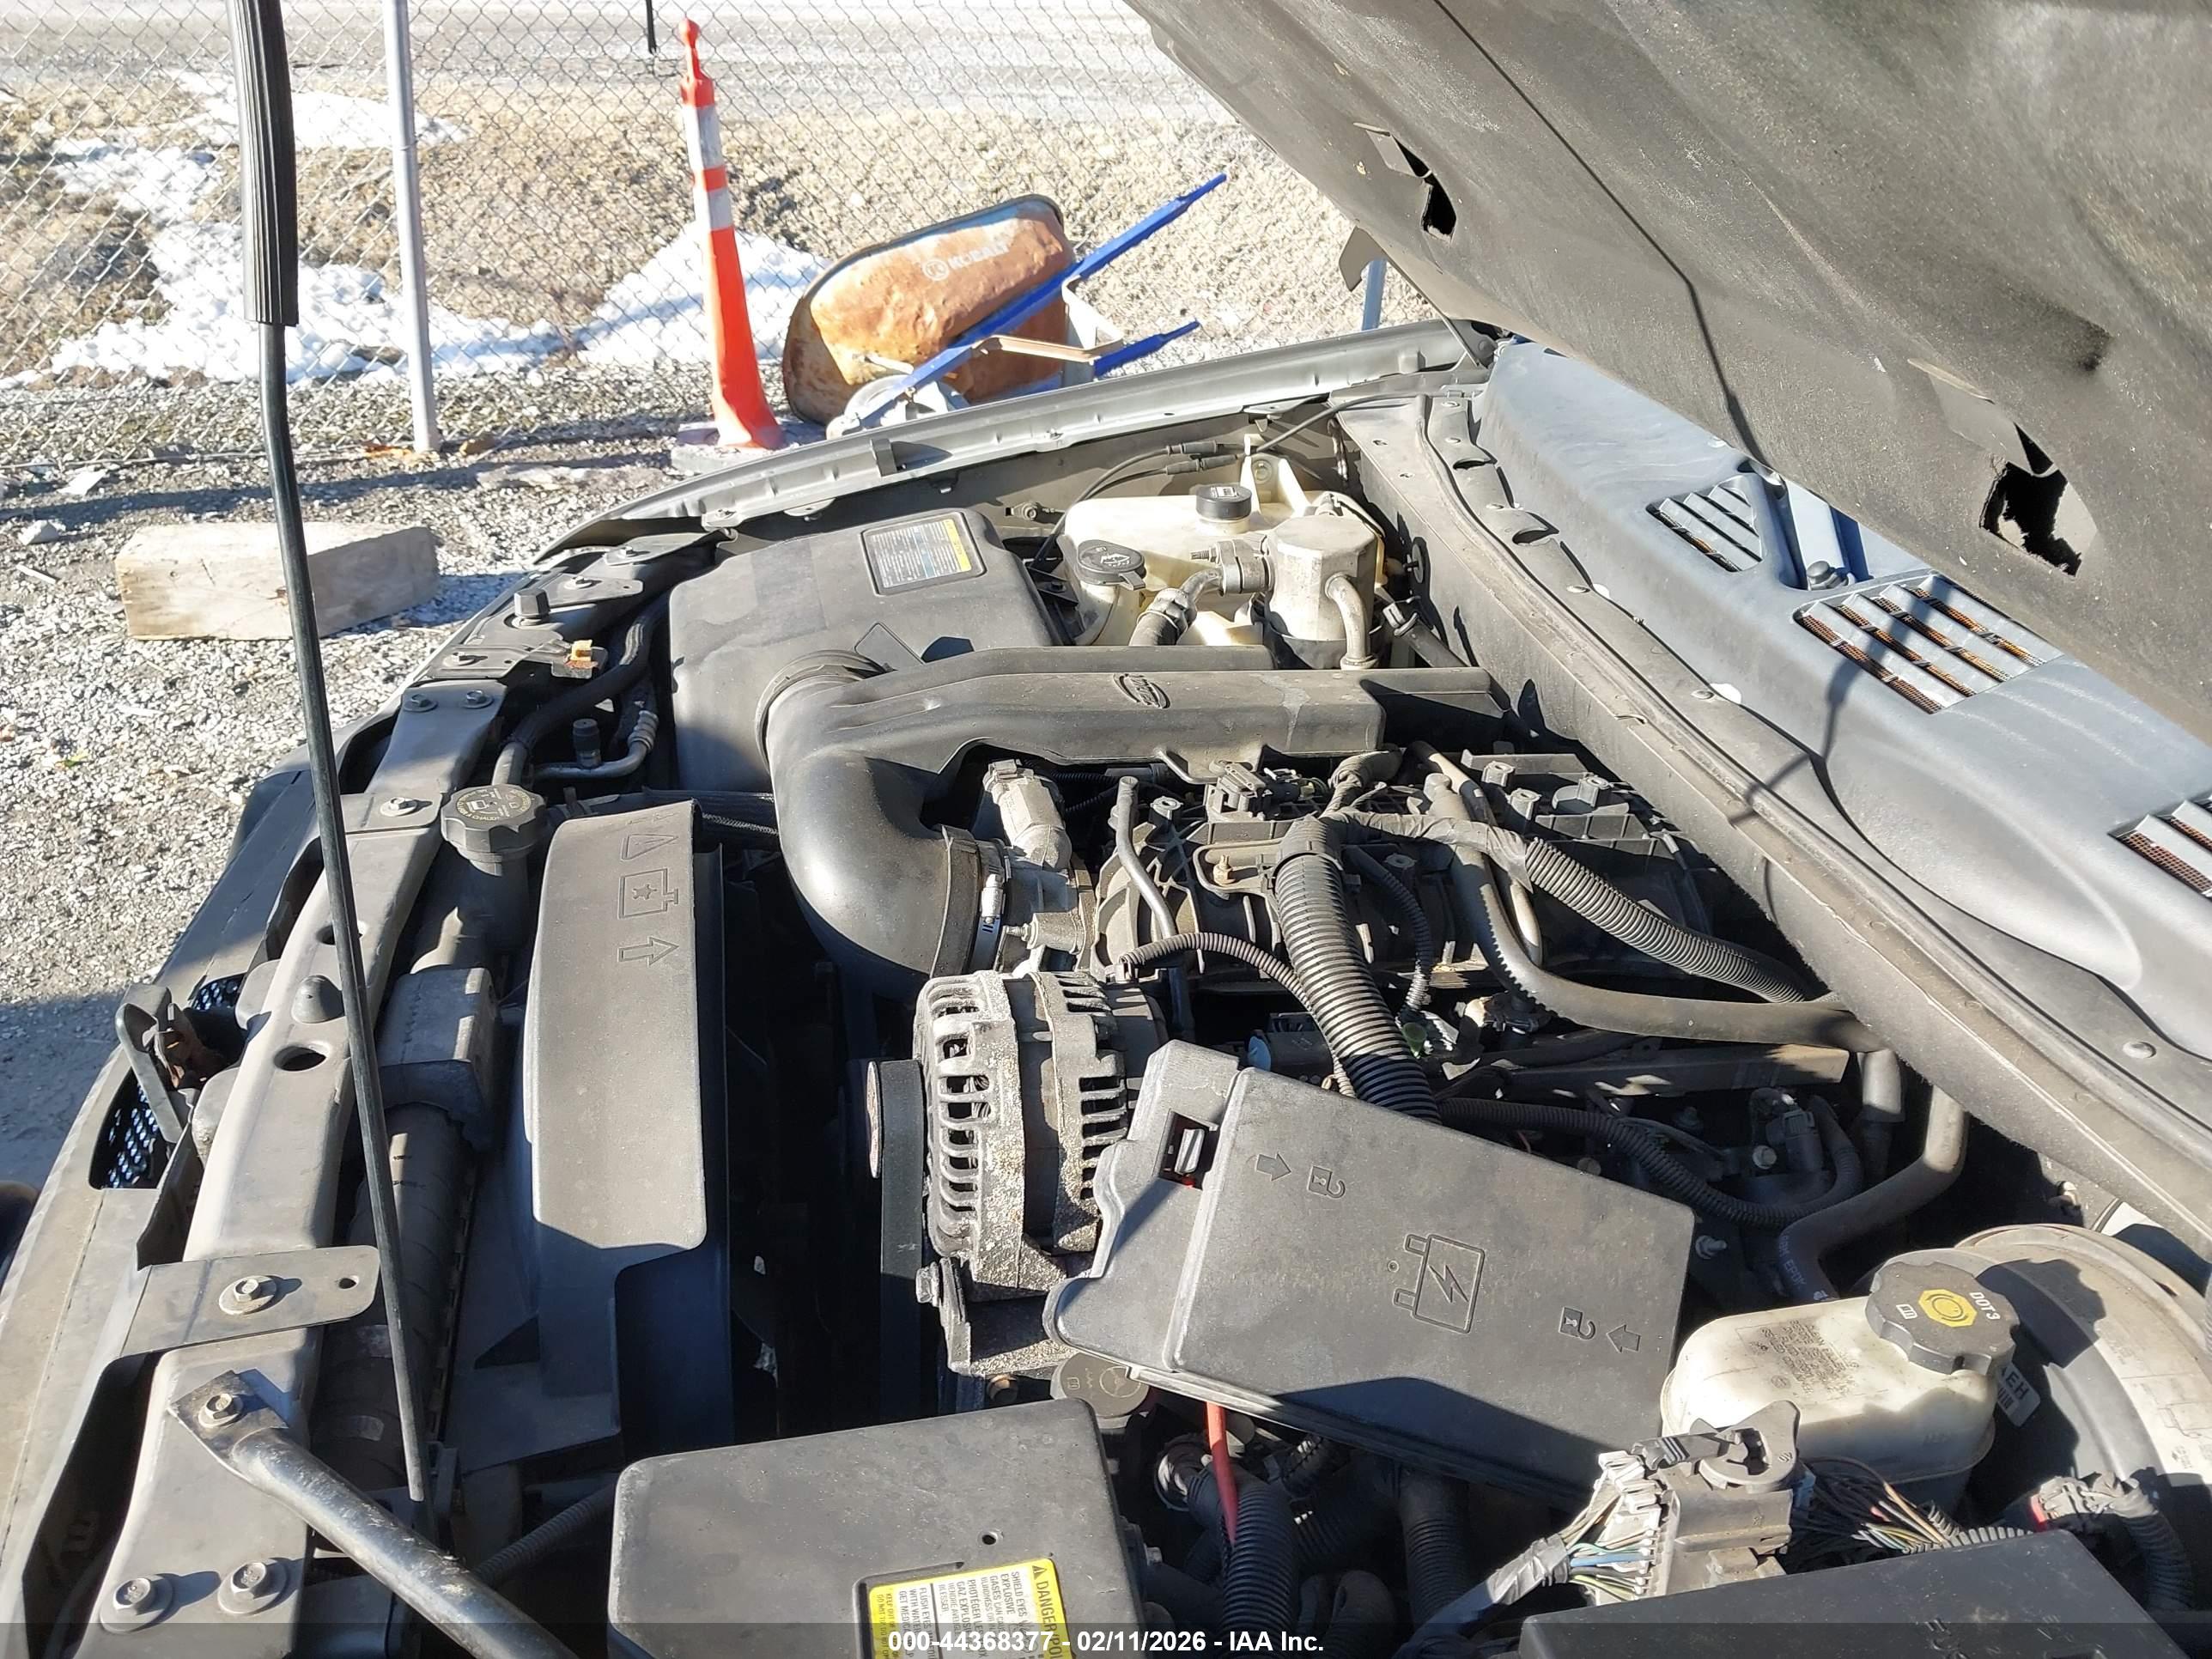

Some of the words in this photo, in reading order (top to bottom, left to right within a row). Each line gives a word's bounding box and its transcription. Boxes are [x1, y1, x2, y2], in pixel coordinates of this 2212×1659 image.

[2001, 1370, 2028, 1400] EH
[956, 1582, 966, 1596] GAZ
[1000, 1573, 1015, 1614] EXPLOSIVE
[1011, 1571, 1024, 1597] SHIELD
[898, 1590, 908, 1604] GET
[908, 1589, 918, 1607] WITH
[919, 1588, 929, 1609] FLUSH
[967, 1579, 983, 1619] PROTÉGER
[1016, 1598, 1027, 1617] EYES
[921, 1611, 932, 1629] EYES
